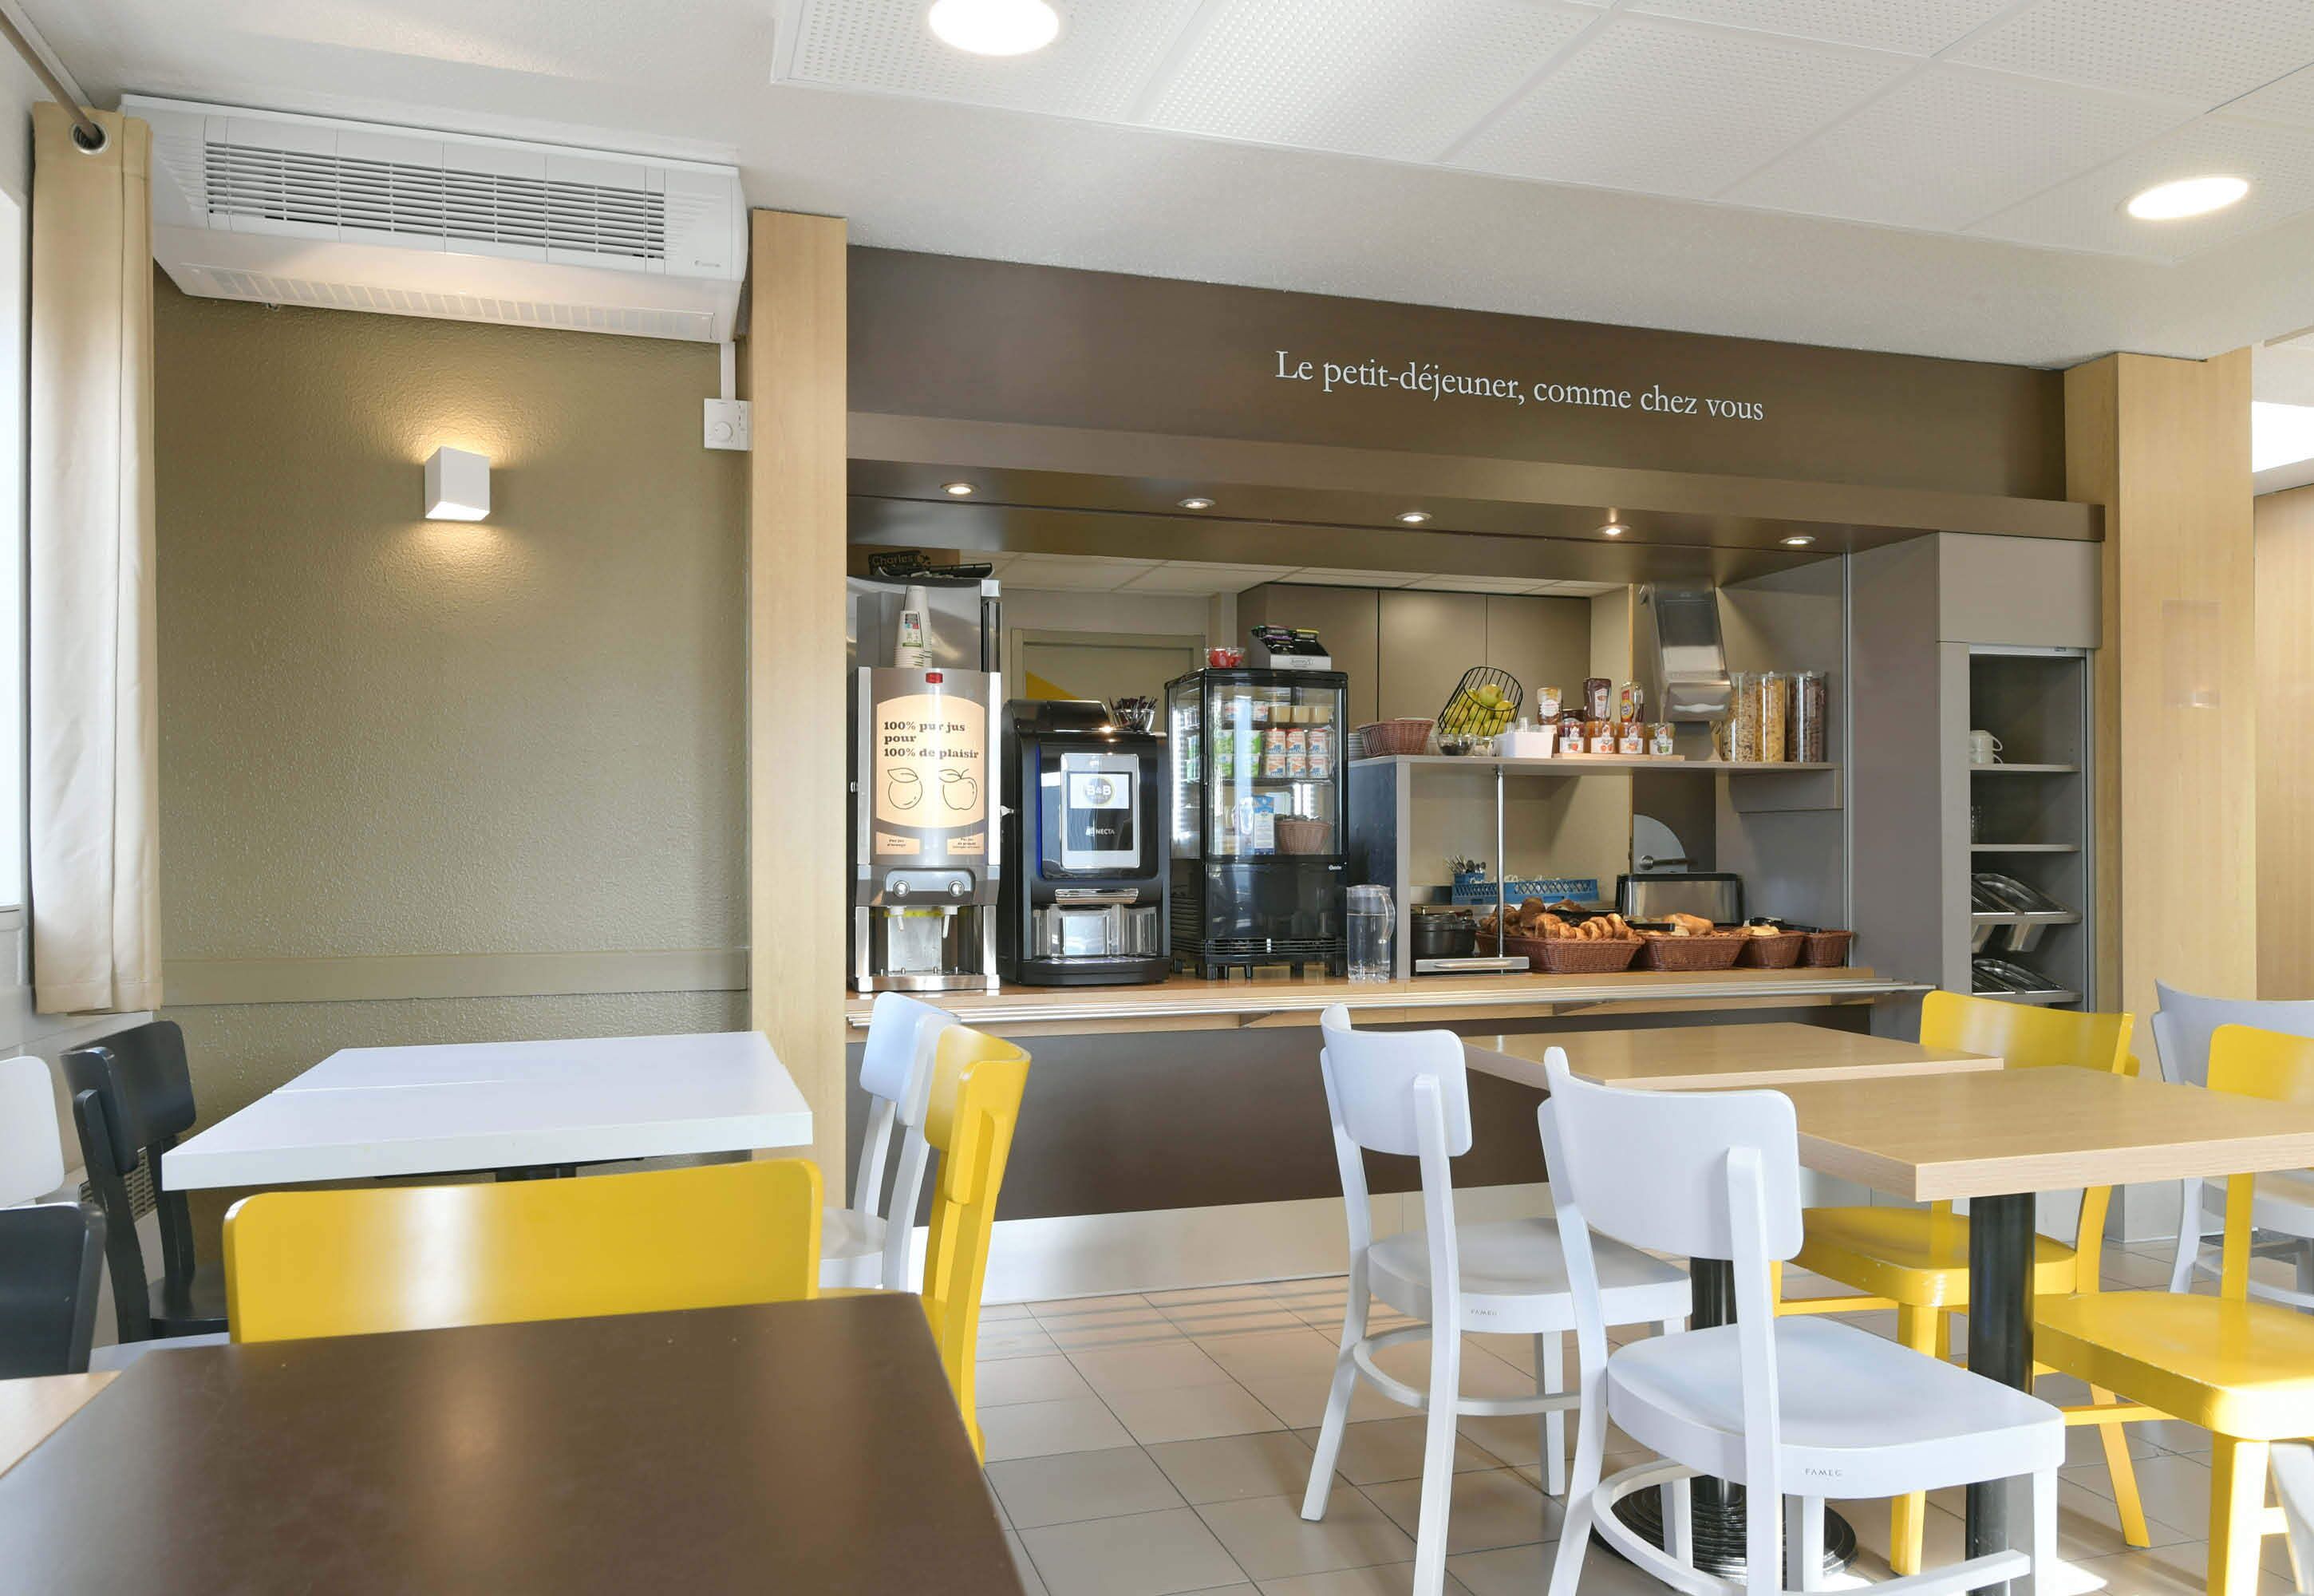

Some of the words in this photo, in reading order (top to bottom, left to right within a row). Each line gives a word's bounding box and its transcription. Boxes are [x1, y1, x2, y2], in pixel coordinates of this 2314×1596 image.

[1275, 350, 1314, 381] Le
[1322, 358, 1526, 404] petit-déjeuner,
[1533, 381, 1632, 409] comme
[1640, 385, 1698, 415] chez
[1705, 398, 1764, 421] vous
[883, 721, 916, 730] 100%
[918, 722, 944, 733] pur
[946, 722, 965, 733] jus
[883, 735, 917, 745] pour
[883, 748, 916, 757] 100%
[938, 749, 979, 760] plaisir
[1086, 784, 1112, 796] B&B
